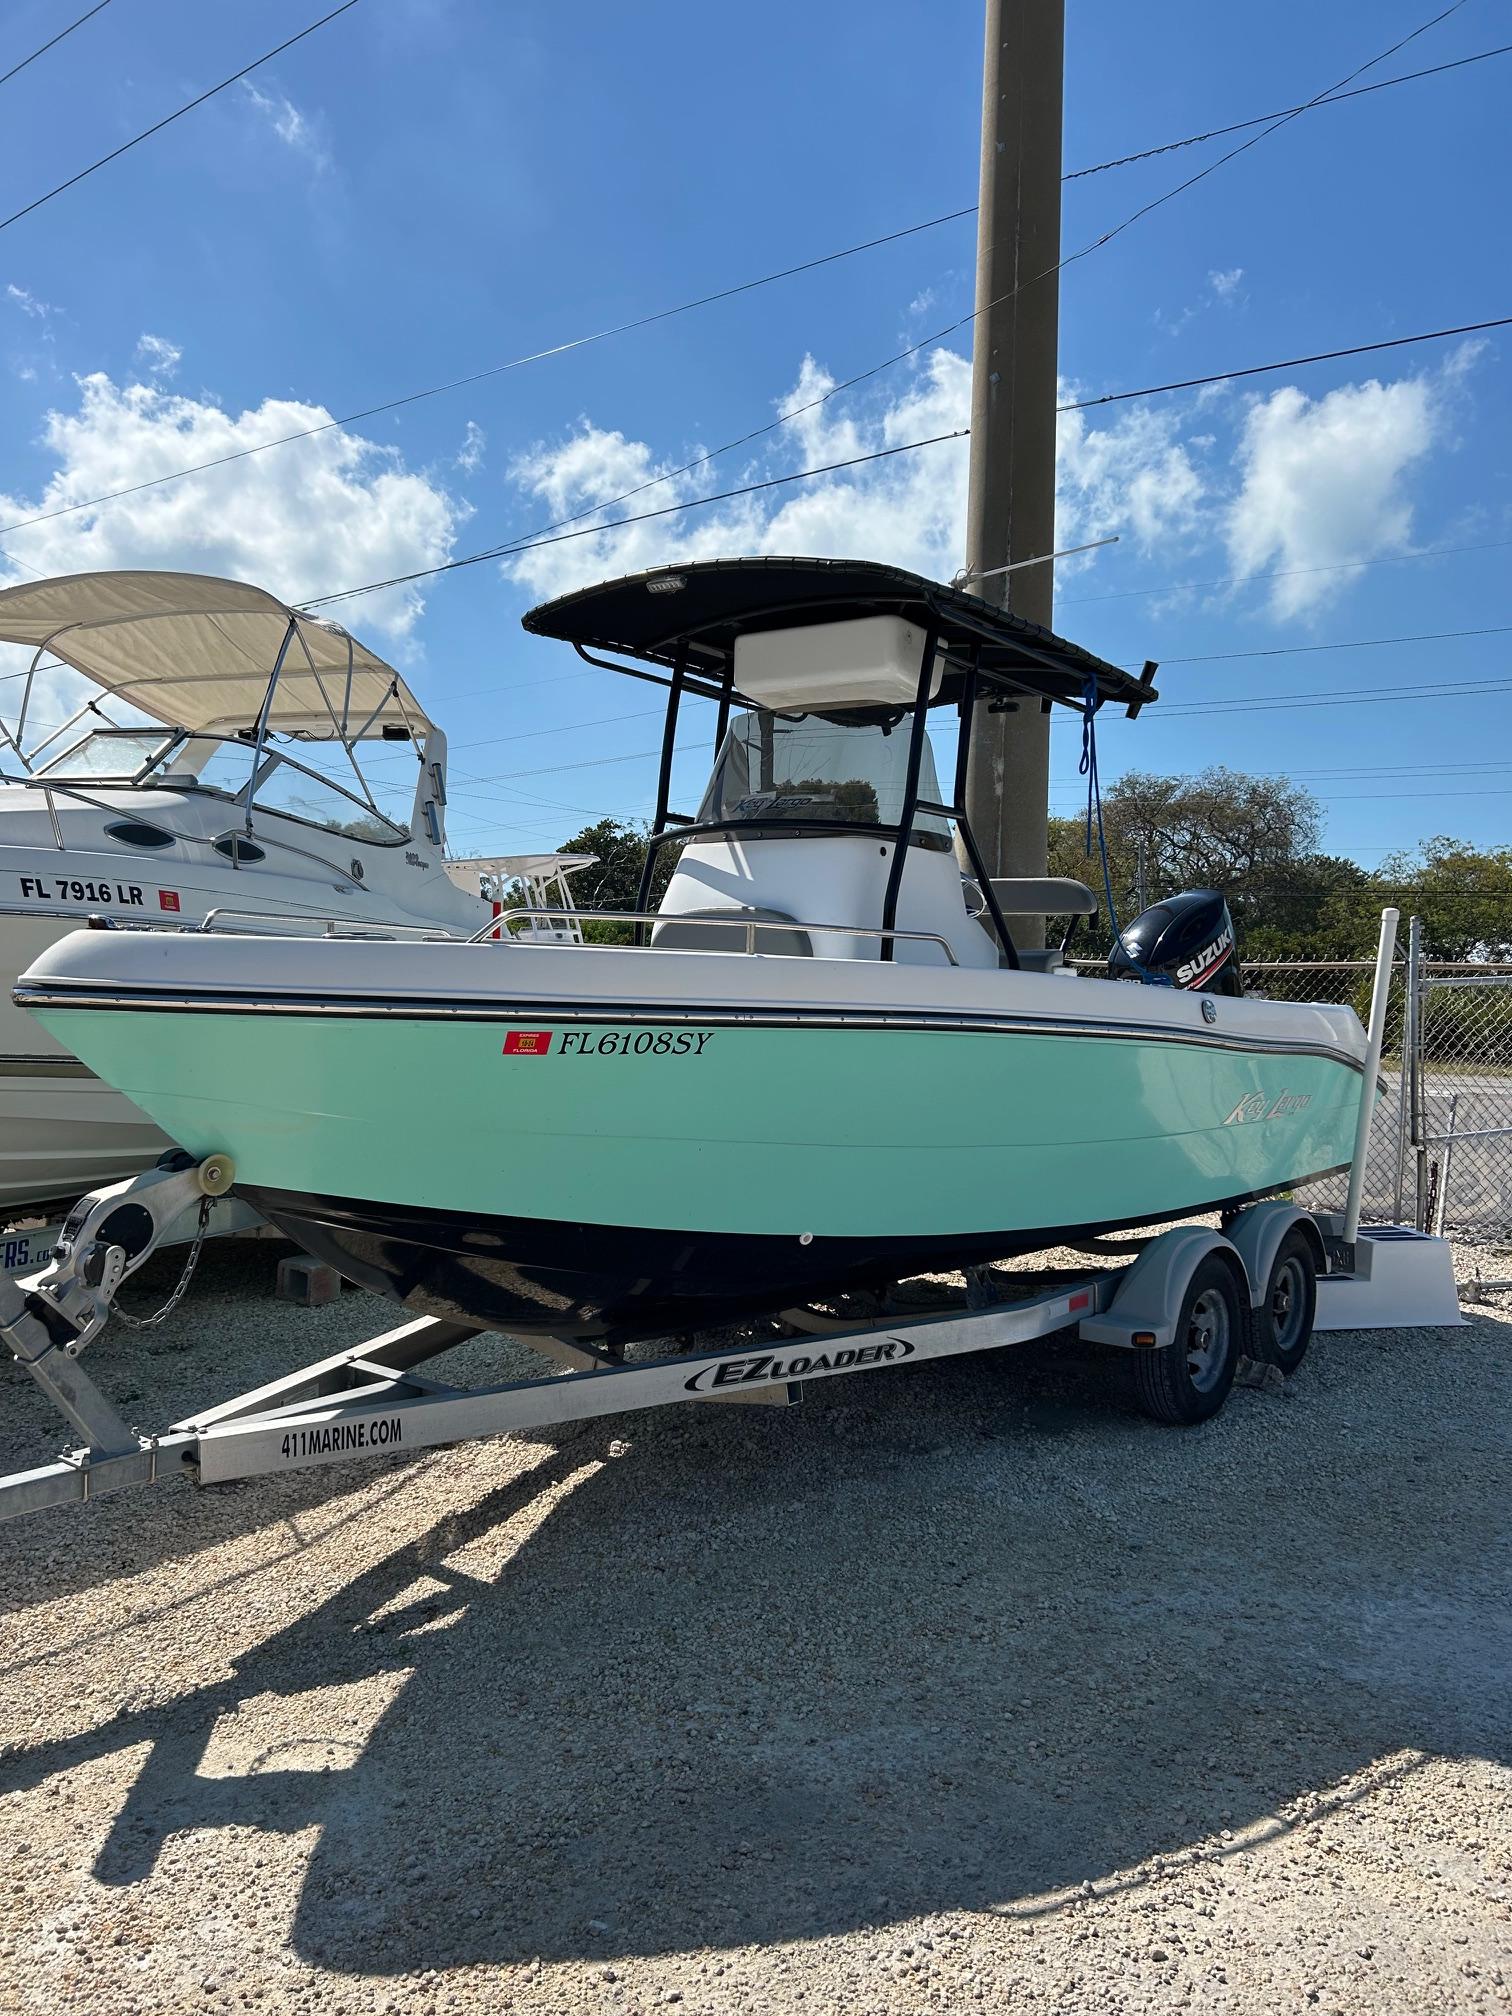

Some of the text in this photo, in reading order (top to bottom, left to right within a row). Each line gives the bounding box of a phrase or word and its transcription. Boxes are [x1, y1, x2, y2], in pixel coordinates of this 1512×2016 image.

[20, 878, 144, 906] FL 7916 LR
[557, 1031, 715, 1056] FL6108SY
[281, 1417, 402, 1458] 411MARINE.COM
